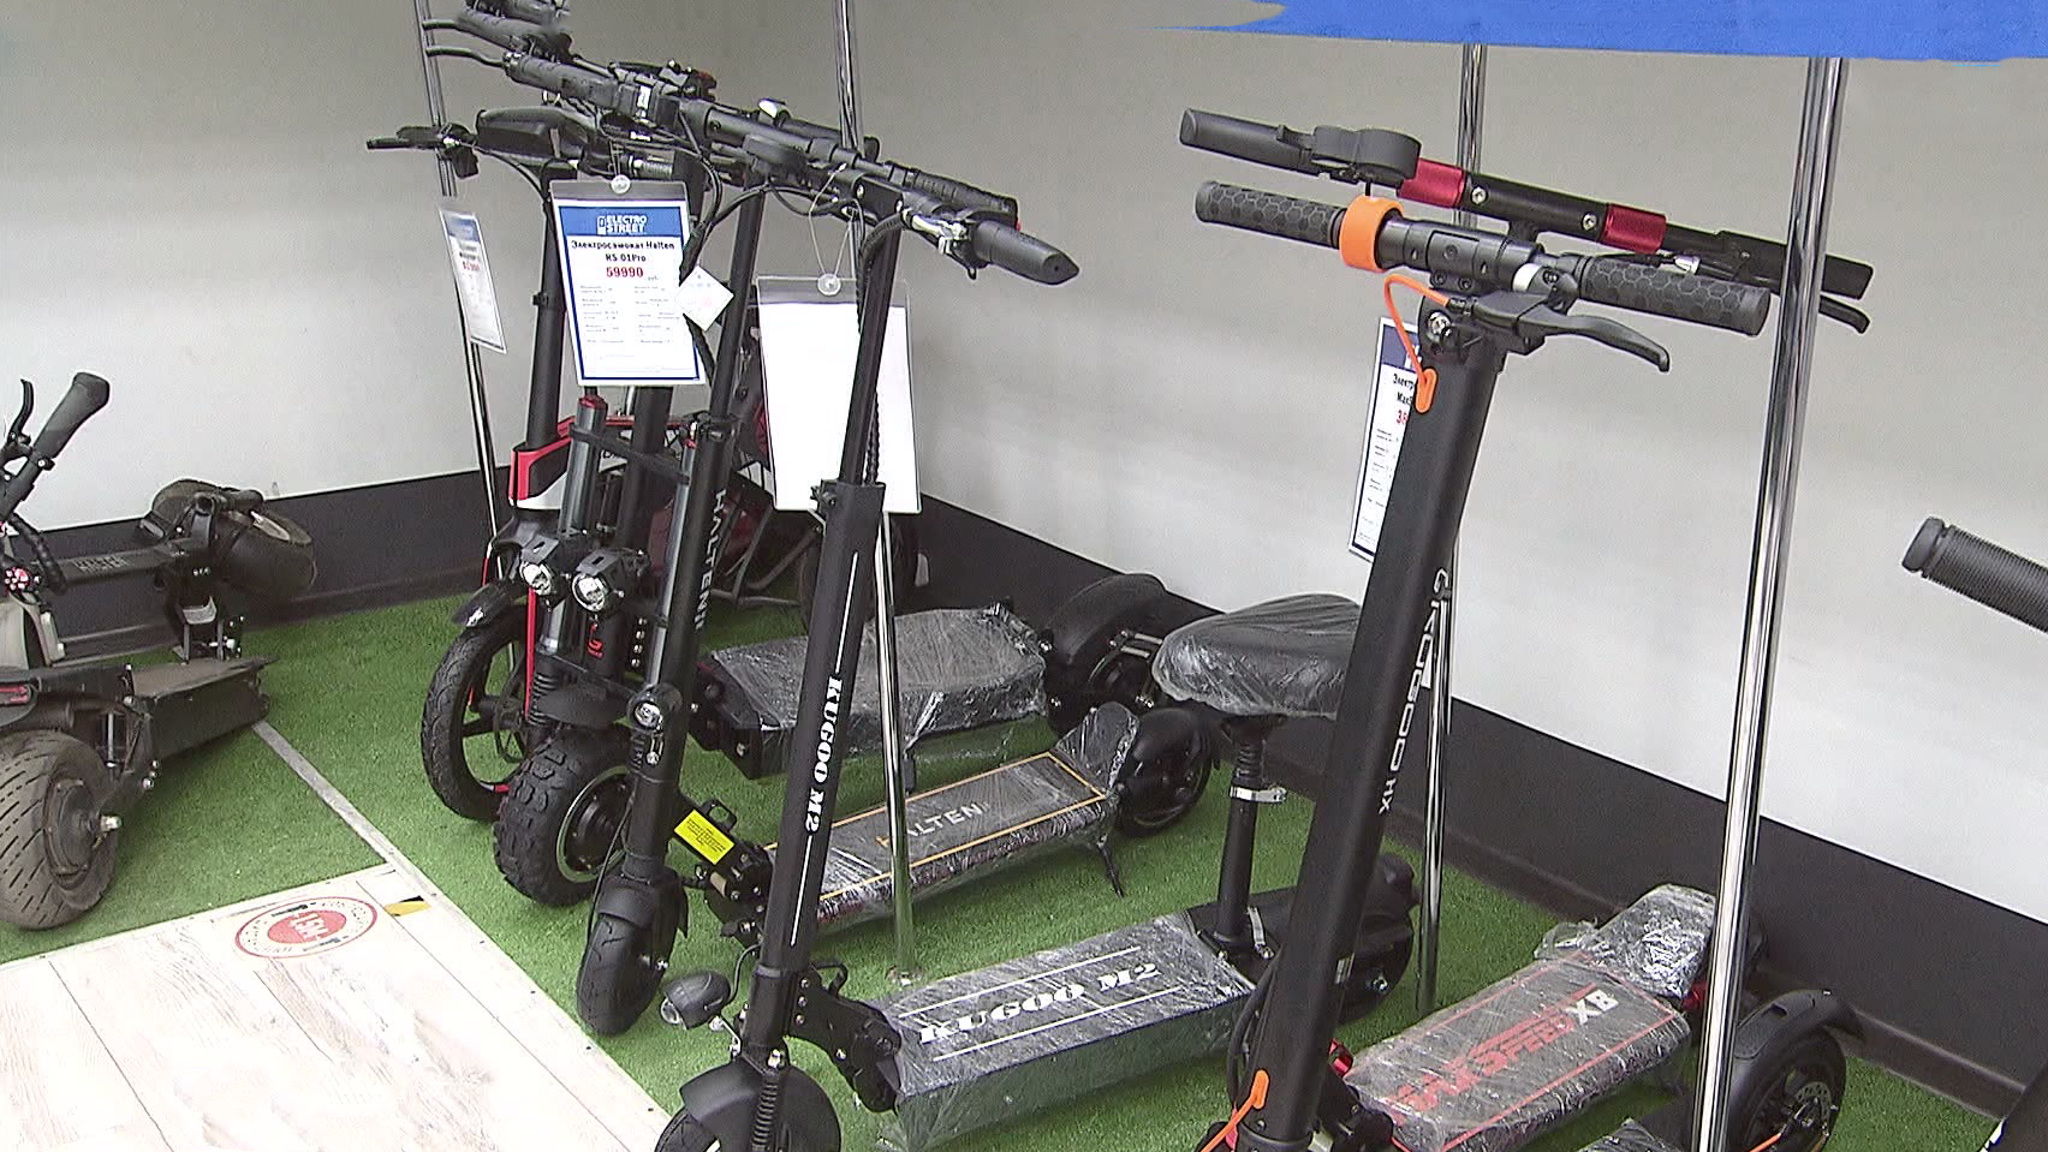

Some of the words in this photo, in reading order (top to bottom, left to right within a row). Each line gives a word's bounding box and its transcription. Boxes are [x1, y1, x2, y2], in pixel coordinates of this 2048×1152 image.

[606, 214, 648, 225] ELECTRO
[606, 224, 646, 234] STREET
[606, 266, 644, 278] 59990
[813, 675, 843, 783] KUGOO
[805, 787, 825, 834] M2
[919, 983, 1086, 1045] KUGOO
[1098, 962, 1162, 992] M2
